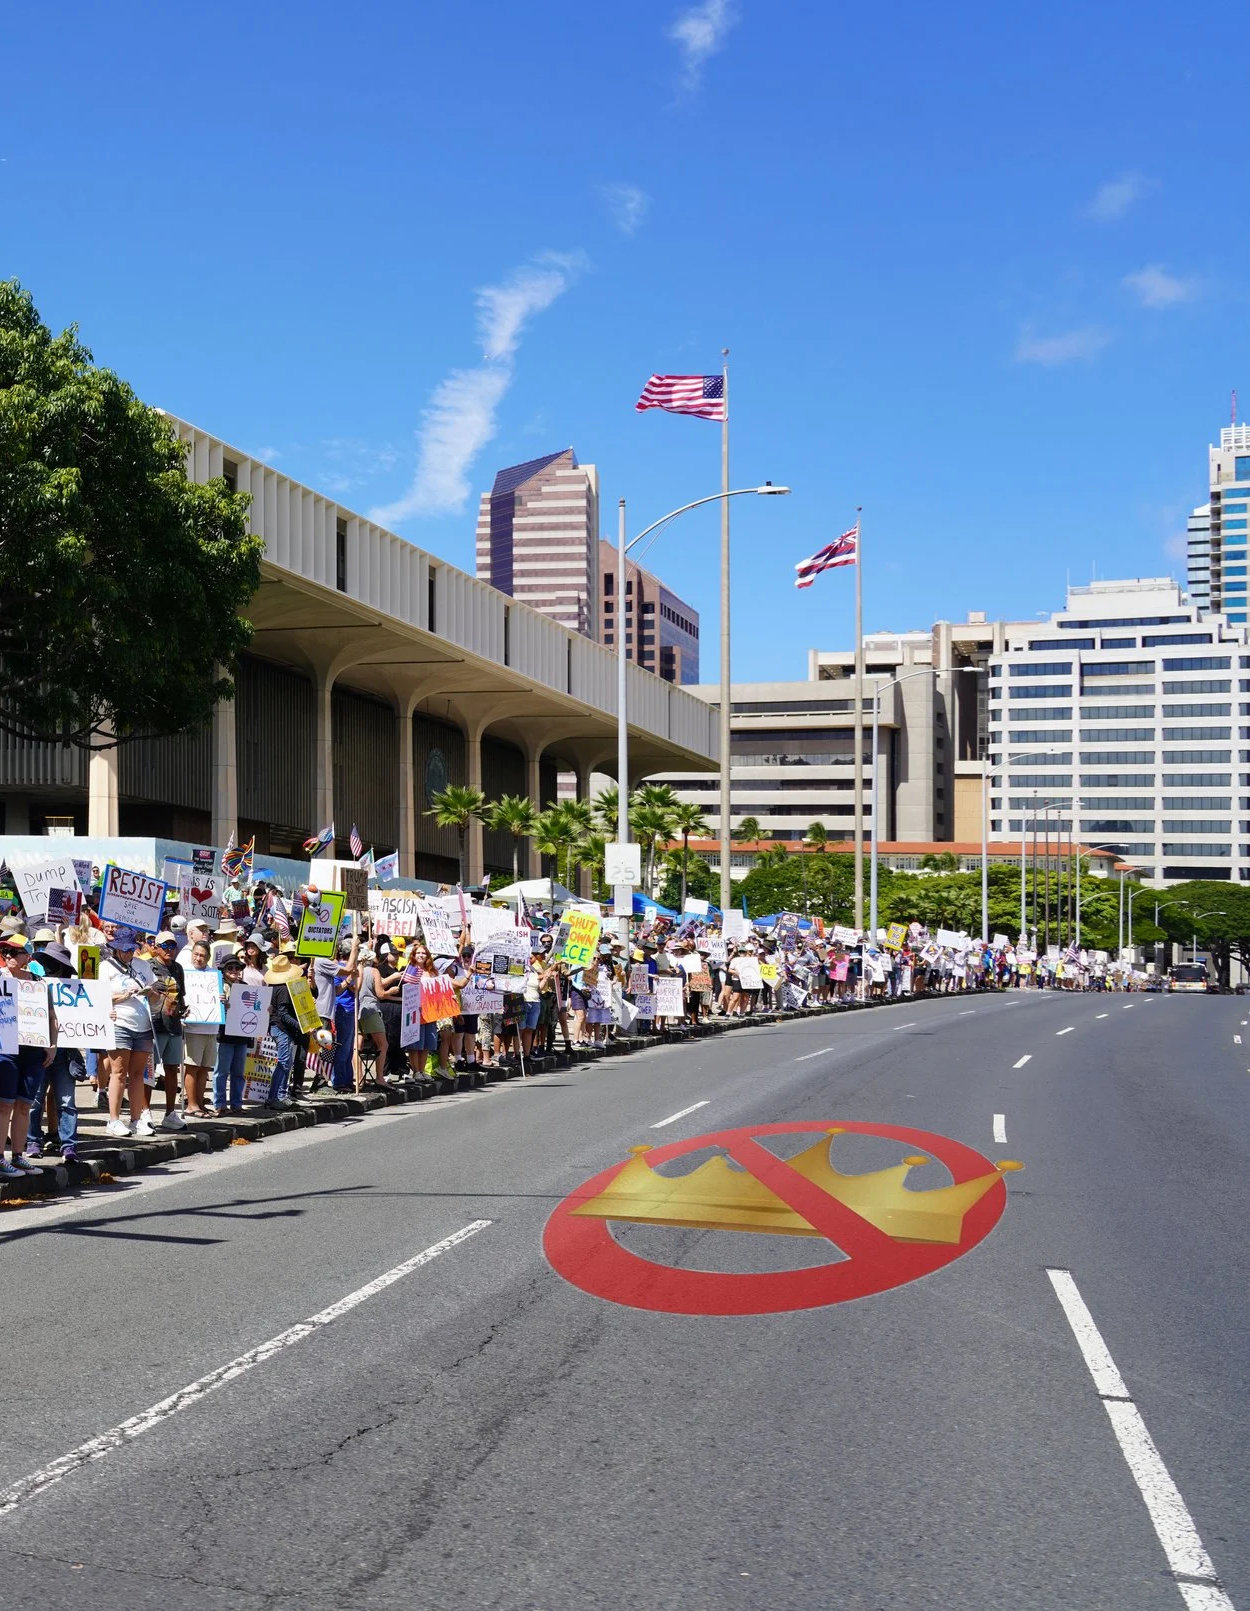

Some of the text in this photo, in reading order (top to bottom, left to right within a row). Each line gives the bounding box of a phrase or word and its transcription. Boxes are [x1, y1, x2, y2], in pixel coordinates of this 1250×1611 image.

[24, 866, 65, 888] Dump
[610, 865, 636, 881] 25
[110, 868, 163, 903] RESIST
[124, 901, 137, 910] SAVE
[382, 899, 417, 914] ASCISM
[114, 912, 150, 928] DEMOCRACY
[569, 915, 598, 932] SHUT
[376, 921, 413, 936] HERE!
[430, 928, 448, 940] BAD
[570, 931, 596, 947] OWN
[561, 944, 590, 963] ICE
[48, 983, 93, 1007] USA
[57, 1023, 106, 1038] ASCISM
